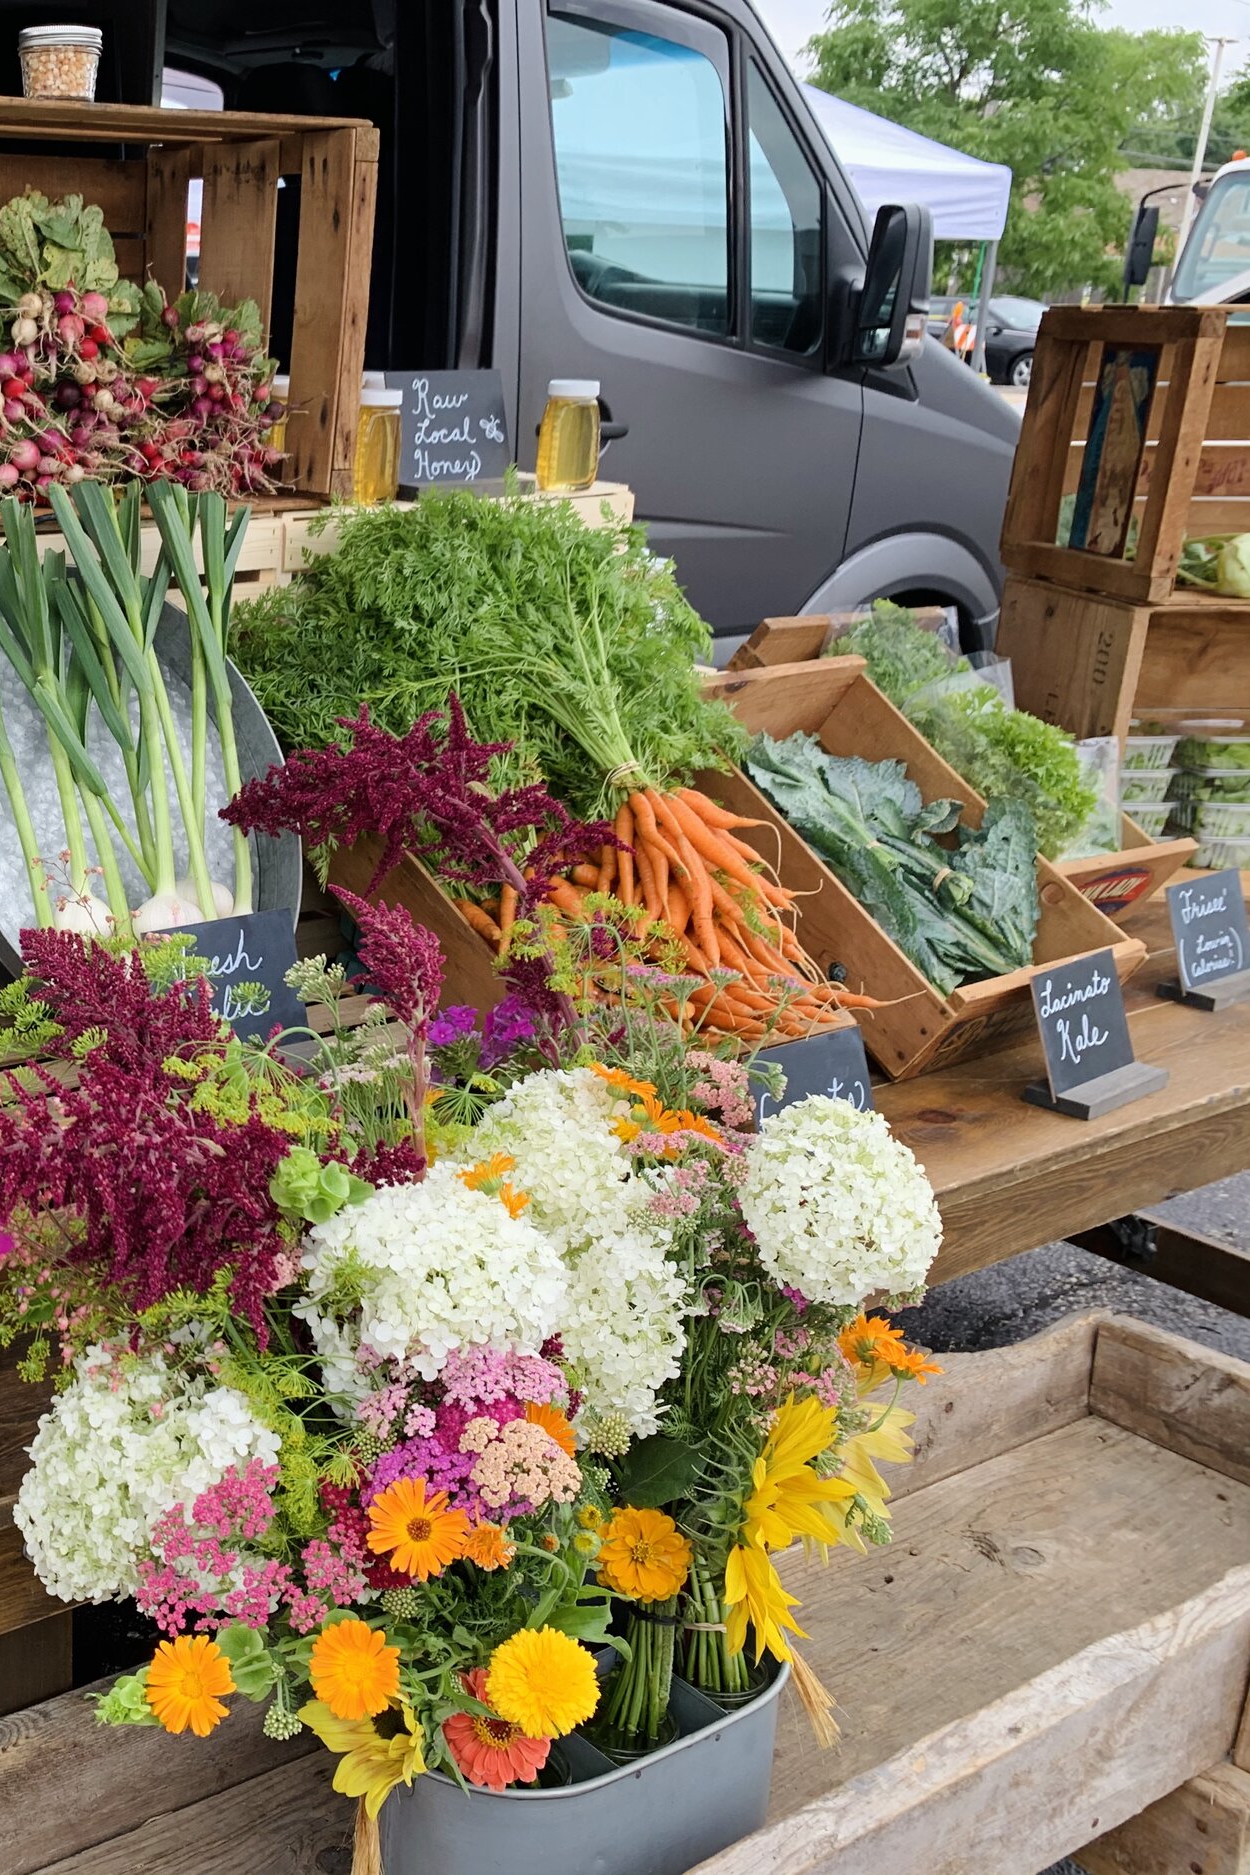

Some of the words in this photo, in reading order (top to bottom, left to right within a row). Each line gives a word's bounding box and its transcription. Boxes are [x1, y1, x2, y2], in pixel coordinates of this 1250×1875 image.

[412, 378, 468, 418] Raw
[415, 416, 476, 445] Local
[414, 448, 481, 481] Honey
[1041, 970, 1111, 1018] Lacinato
[1056, 1014, 1109, 1064] Kale
